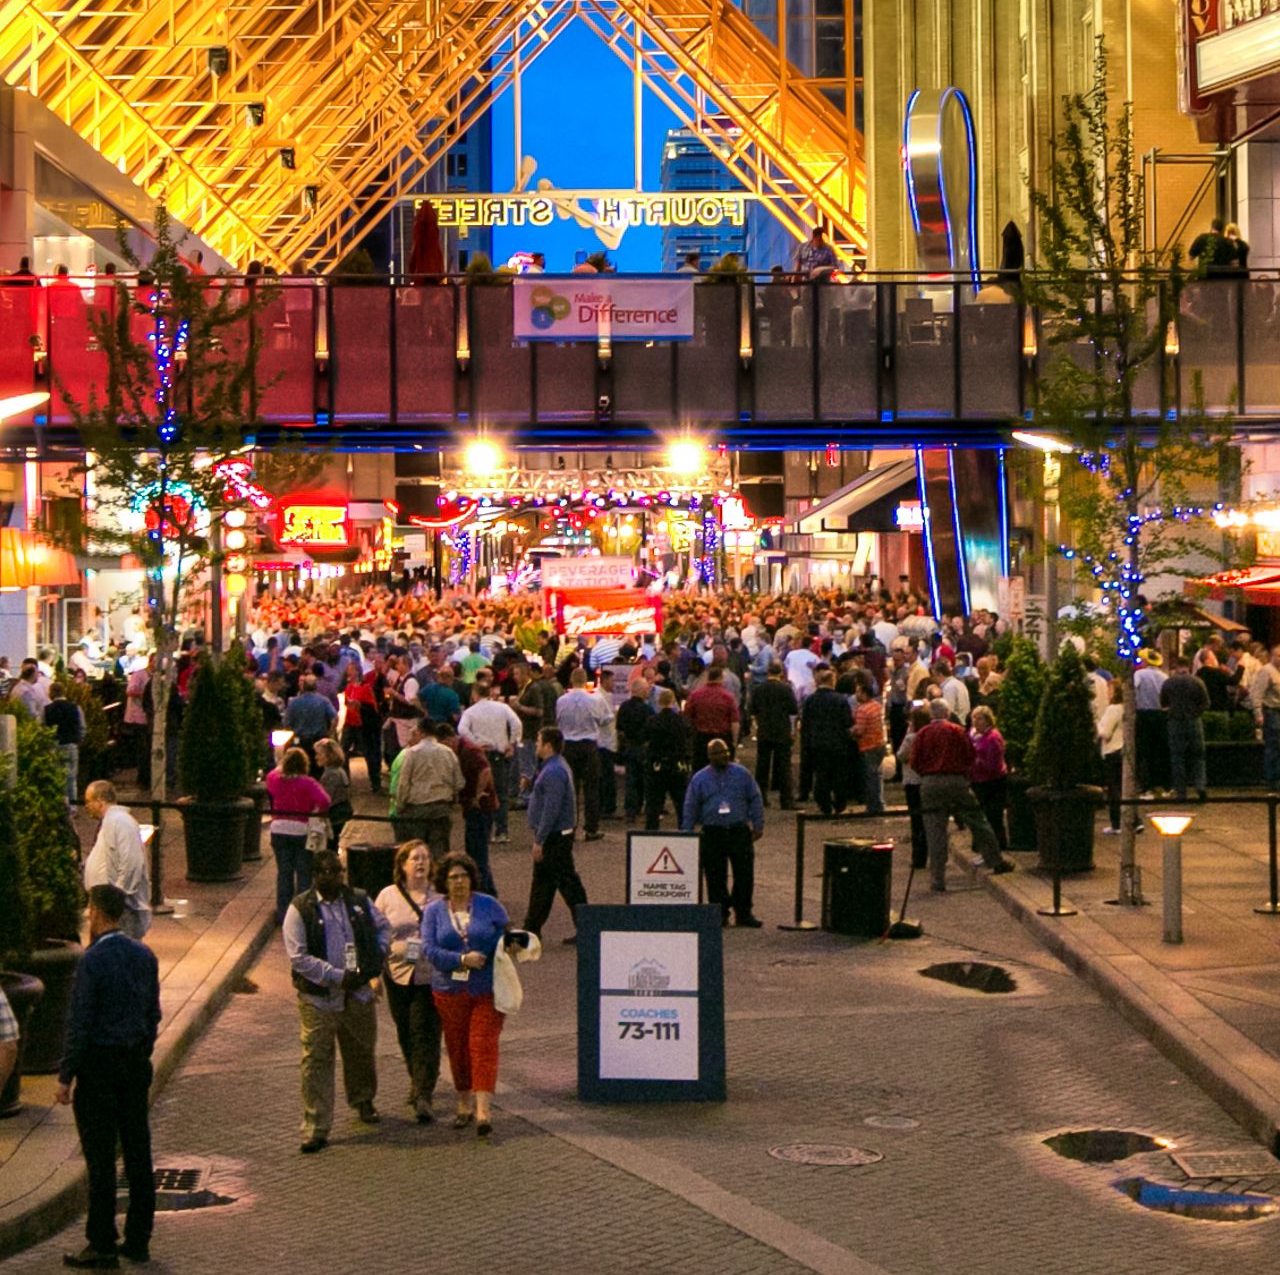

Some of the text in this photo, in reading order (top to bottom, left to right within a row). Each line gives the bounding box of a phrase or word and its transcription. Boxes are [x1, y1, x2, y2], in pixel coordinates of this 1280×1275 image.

[574, 292, 604, 304] Make
[578, 304, 679, 324] Difference
[548, 564, 628, 577] BEVERAGE
[643, 882, 687, 891] NAME TAG
[637, 890, 692, 899] CHECKPOINT
[620, 1008, 679, 1019] COACHES
[618, 1021, 680, 1041] 73-111
